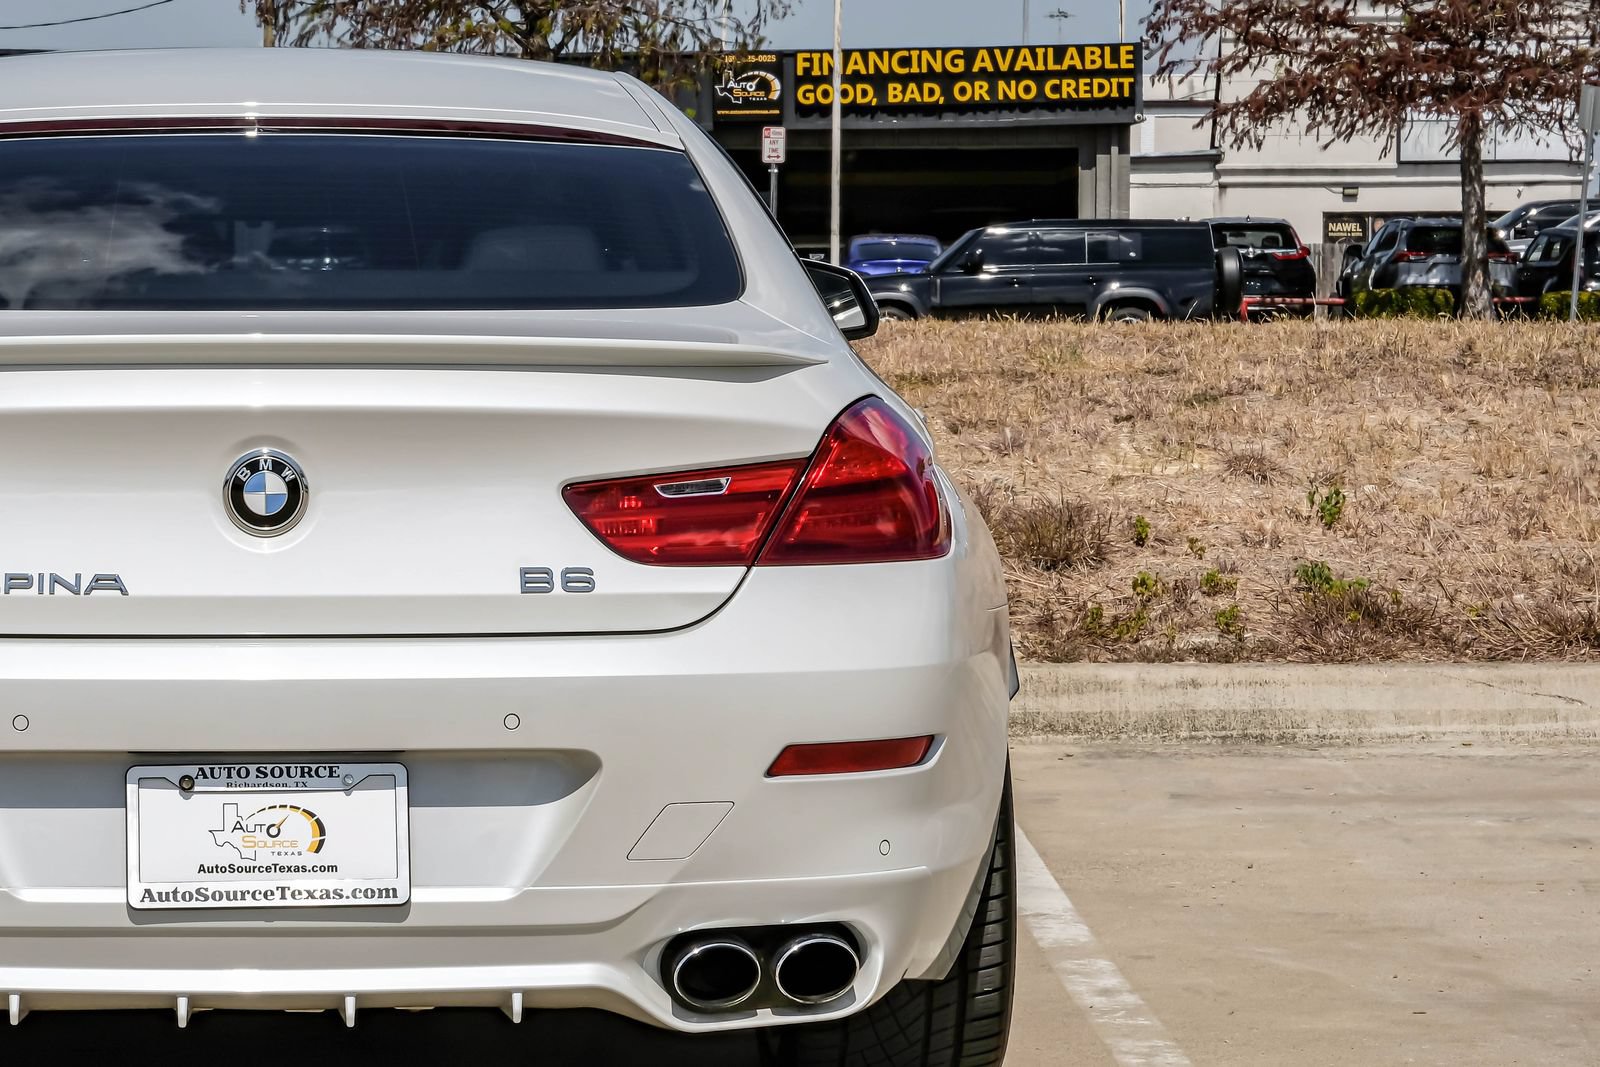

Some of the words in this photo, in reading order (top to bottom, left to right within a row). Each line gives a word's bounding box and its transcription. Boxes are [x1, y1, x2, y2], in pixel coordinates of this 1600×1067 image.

[796, 50, 965, 76] FINANCING
[972, 45, 1134, 72] AVAILABLE
[797, 83, 877, 106] GOOD,
[888, 82, 945, 105] BAD,
[953, 80, 990, 102] OR
[998, 79, 1037, 100] NO
[1044, 77, 1135, 99] CREDIT
[1328, 222, 1362, 232] NAWEL
[236, 458, 296, 482] BMW
[0, 572, 129, 596] PINA
[520, 567, 596, 594] B6
[194, 766, 250, 780] AUTO
[255, 765, 340, 779] SOURCE
[231, 820, 281, 838] AUTO
[242, 835, 298, 849] SOURCE
[197, 863, 338, 874] AutoSourceTexas.com
[139, 886, 399, 903] AutoSourceTexas.com
